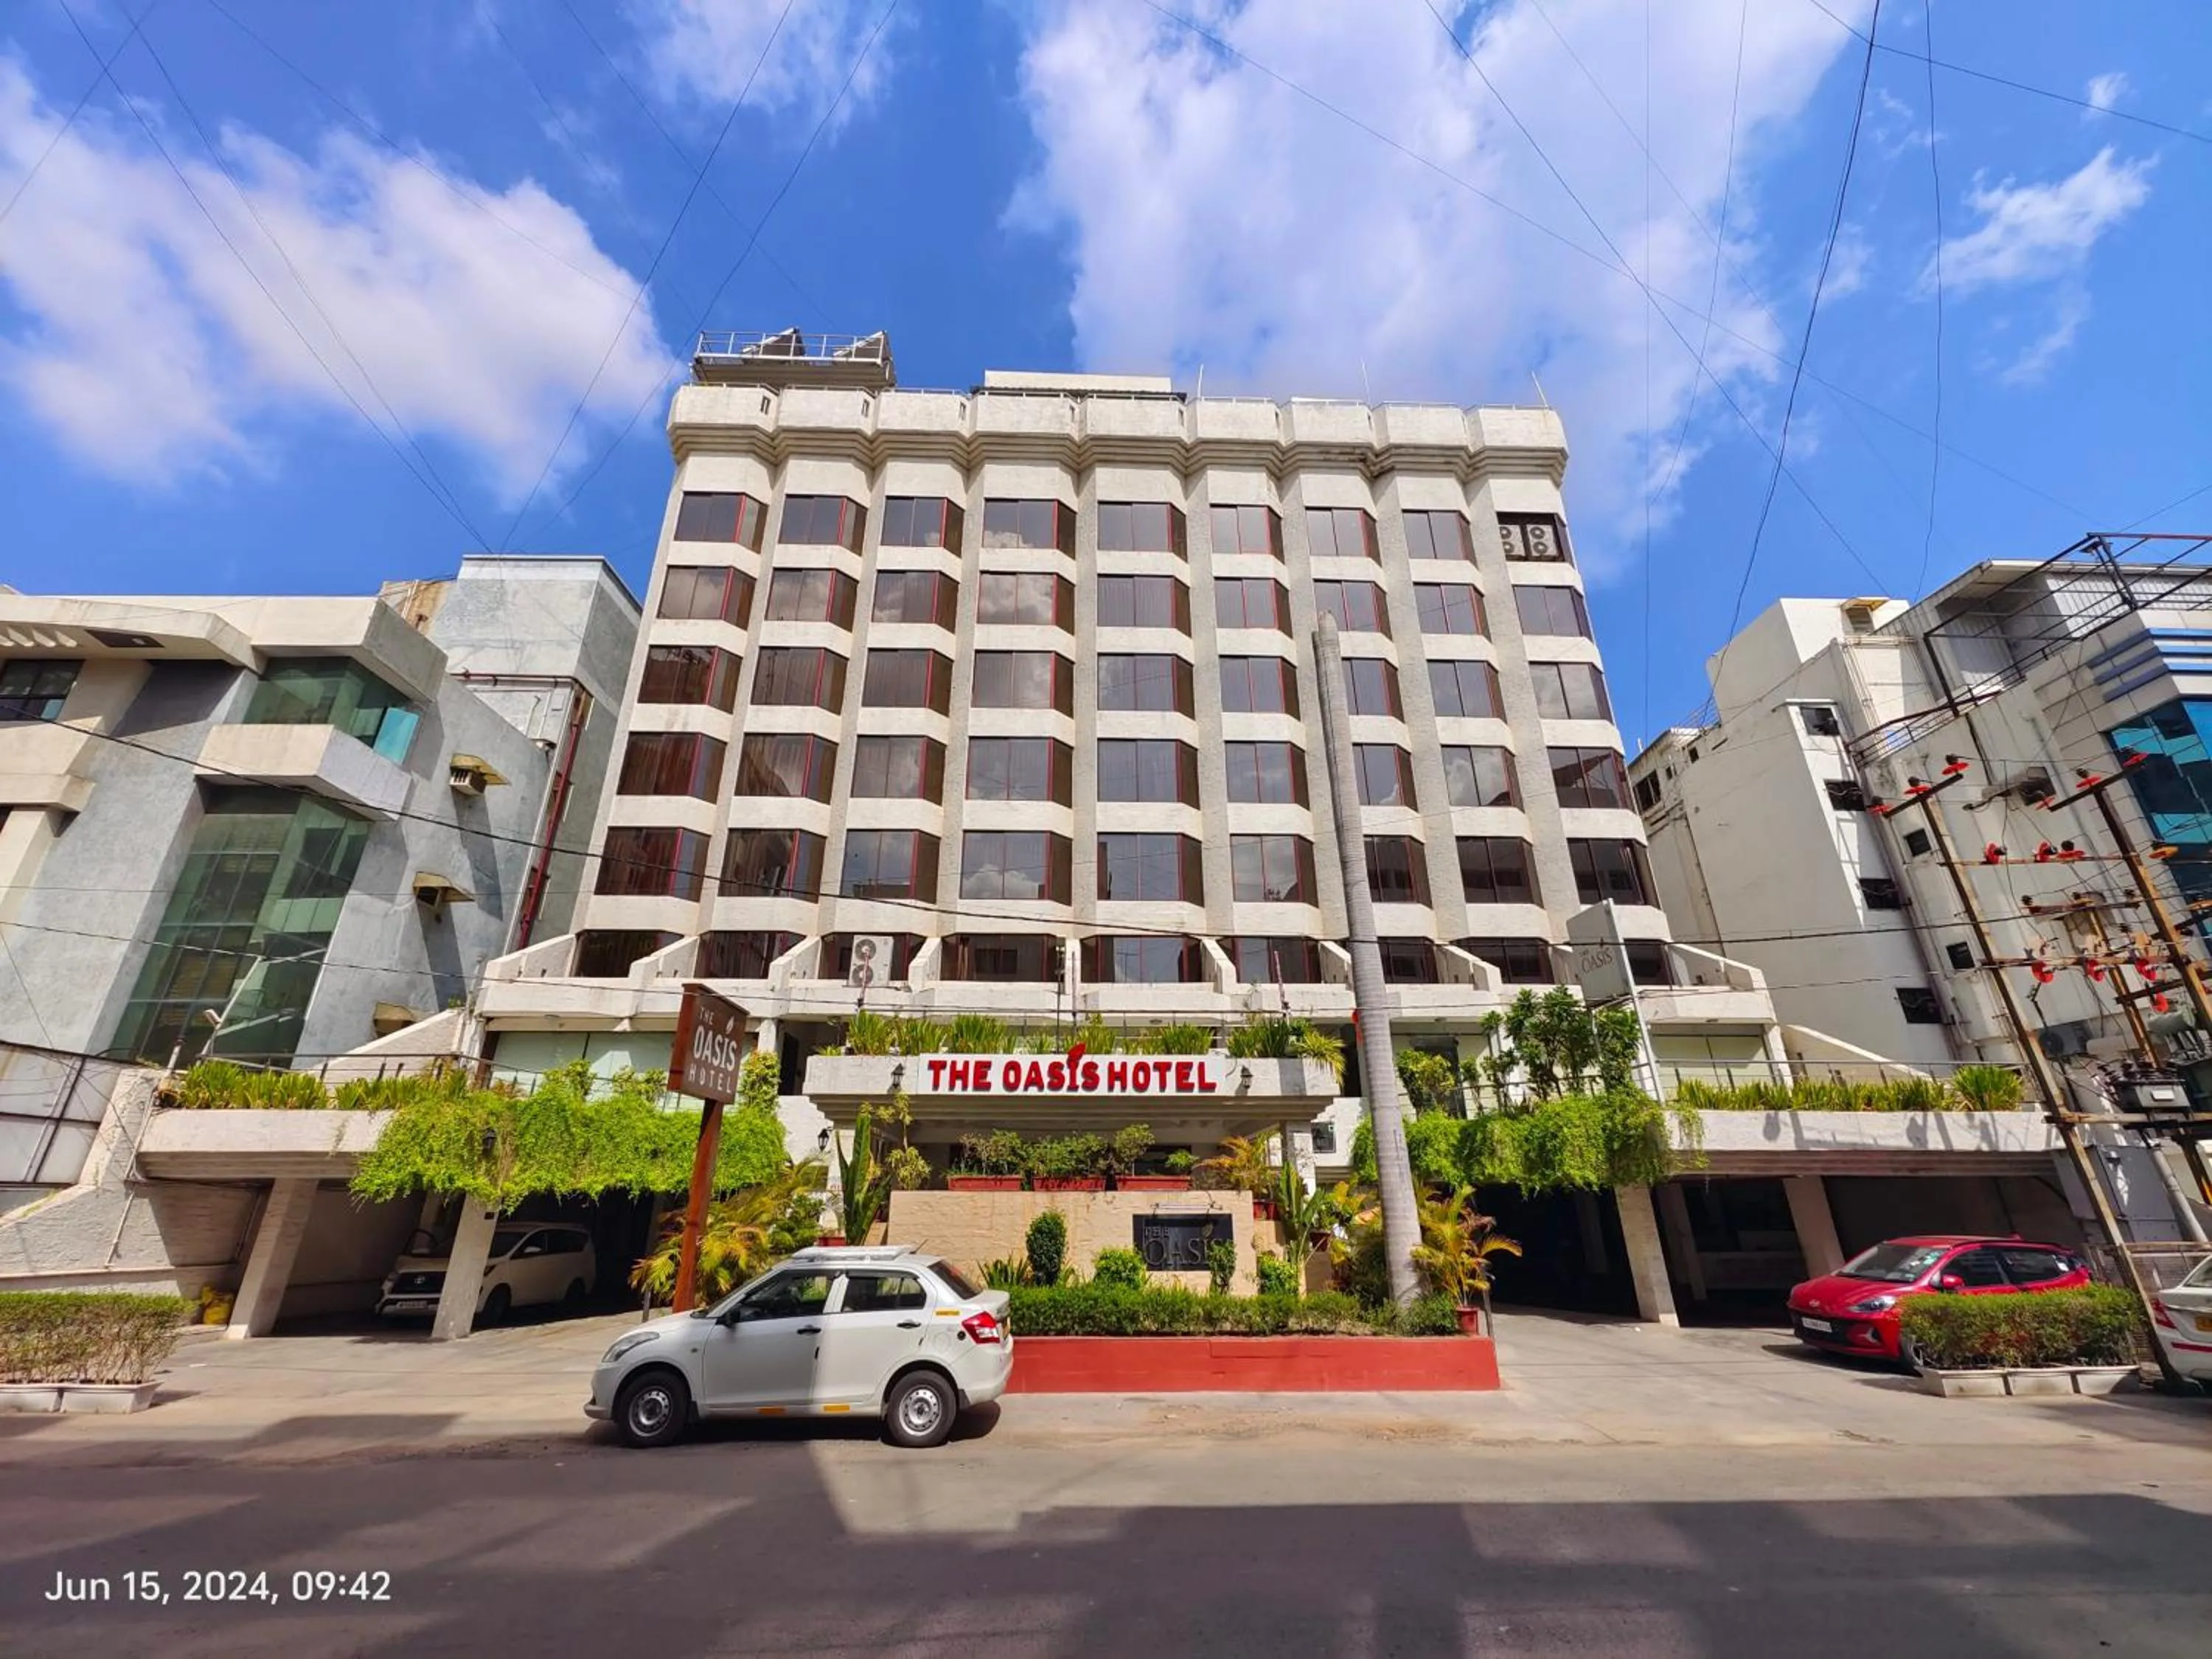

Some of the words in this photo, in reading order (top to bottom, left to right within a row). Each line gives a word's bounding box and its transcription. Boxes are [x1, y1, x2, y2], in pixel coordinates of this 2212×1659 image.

[700, 1007, 714, 1025] THE
[693, 1026, 737, 1071] OASIS
[688, 1063, 732, 1093] HOTEL
[927, 1060, 992, 1091] THE
[1002, 1060, 1100, 1092] OASIS
[1107, 1060, 1217, 1092] HOTEL
